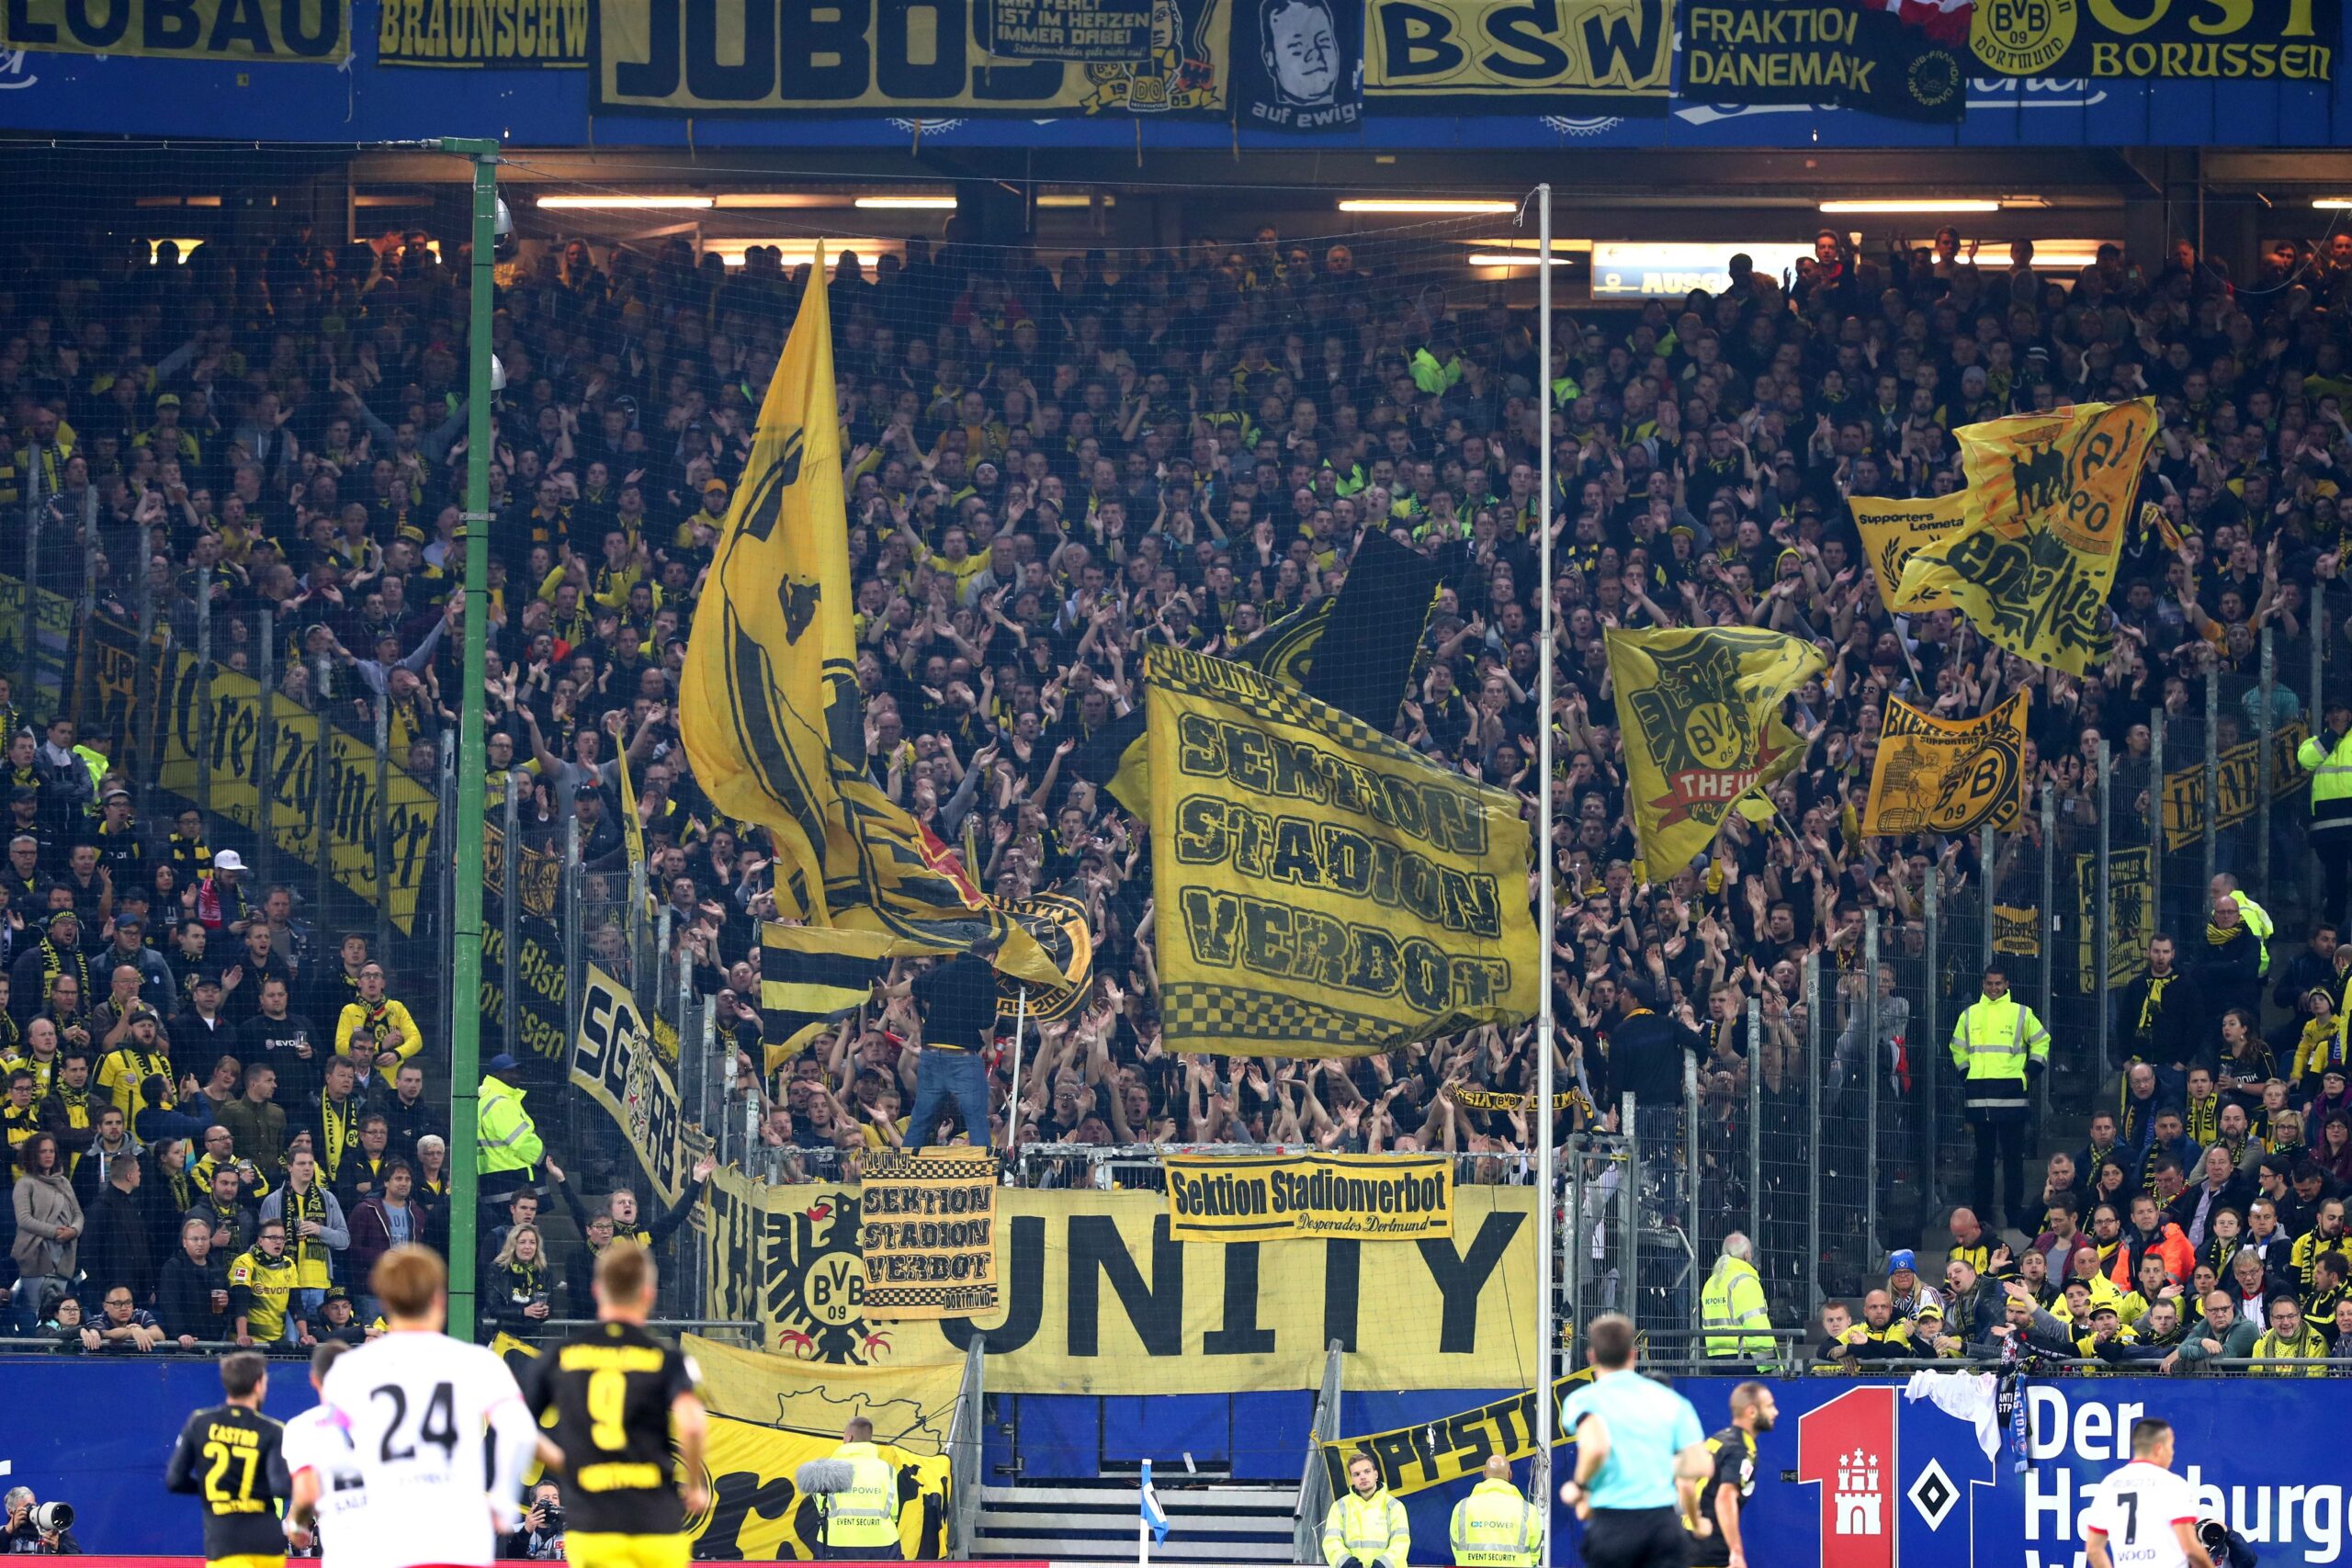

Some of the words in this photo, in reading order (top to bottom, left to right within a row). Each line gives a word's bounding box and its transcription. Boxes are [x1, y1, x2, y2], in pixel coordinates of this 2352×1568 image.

[1995, 0, 2046, 31] BVB
[998, 25, 1065, 44] IMMER
[1380, 0, 1665, 83] BSW
[2009, 30, 2029, 44] 09
[1973, 34, 2065, 70] DORTMUND
[2090, 42, 2332, 81] BORUSSEN
[1859, 512, 1934, 525] Supporters
[1910, 516, 1964, 533] Lenneta
[1720, 746, 1735, 763] 09
[1179, 712, 1488, 855] SEKTION
[1943, 803, 1966, 822] 09
[1175, 794, 1501, 940] STADION
[1179, 886, 1511, 1013] VERBOT
[863, 1184, 993, 1216] SEKTION
[1170, 1170, 1268, 1216] Sektion
[1271, 1168, 1447, 1214] Stadionverbot
[863, 1218, 991, 1250] STADION
[1297, 1211, 1362, 1234] Desperados
[1364, 1214, 1430, 1234] Dortmund
[814, 1260, 865, 1306] BVB
[864, 1251, 991, 1283] VERBOT
[939, 1211, 1529, 1357] UNITY
[827, 1305, 847, 1321] 09
[944, 1290, 992, 1311] DORTMUND
[586, 1367, 628, 1451] 9
[1998, 1393, 2013, 1403] ANTI
[208, 1423, 260, 1448] CASTRO
[369, 1380, 460, 1464] 24
[2027, 1384, 2143, 1461] Der
[202, 1440, 260, 1503] 27
[836, 1517, 854, 1527] EVENT
[2117, 1491, 2138, 1545] 7
[1467, 1552, 1487, 1562] EVENT
[1487, 1552, 1517, 1562] SECURITY
[2117, 1548, 2156, 1562] WOOD
